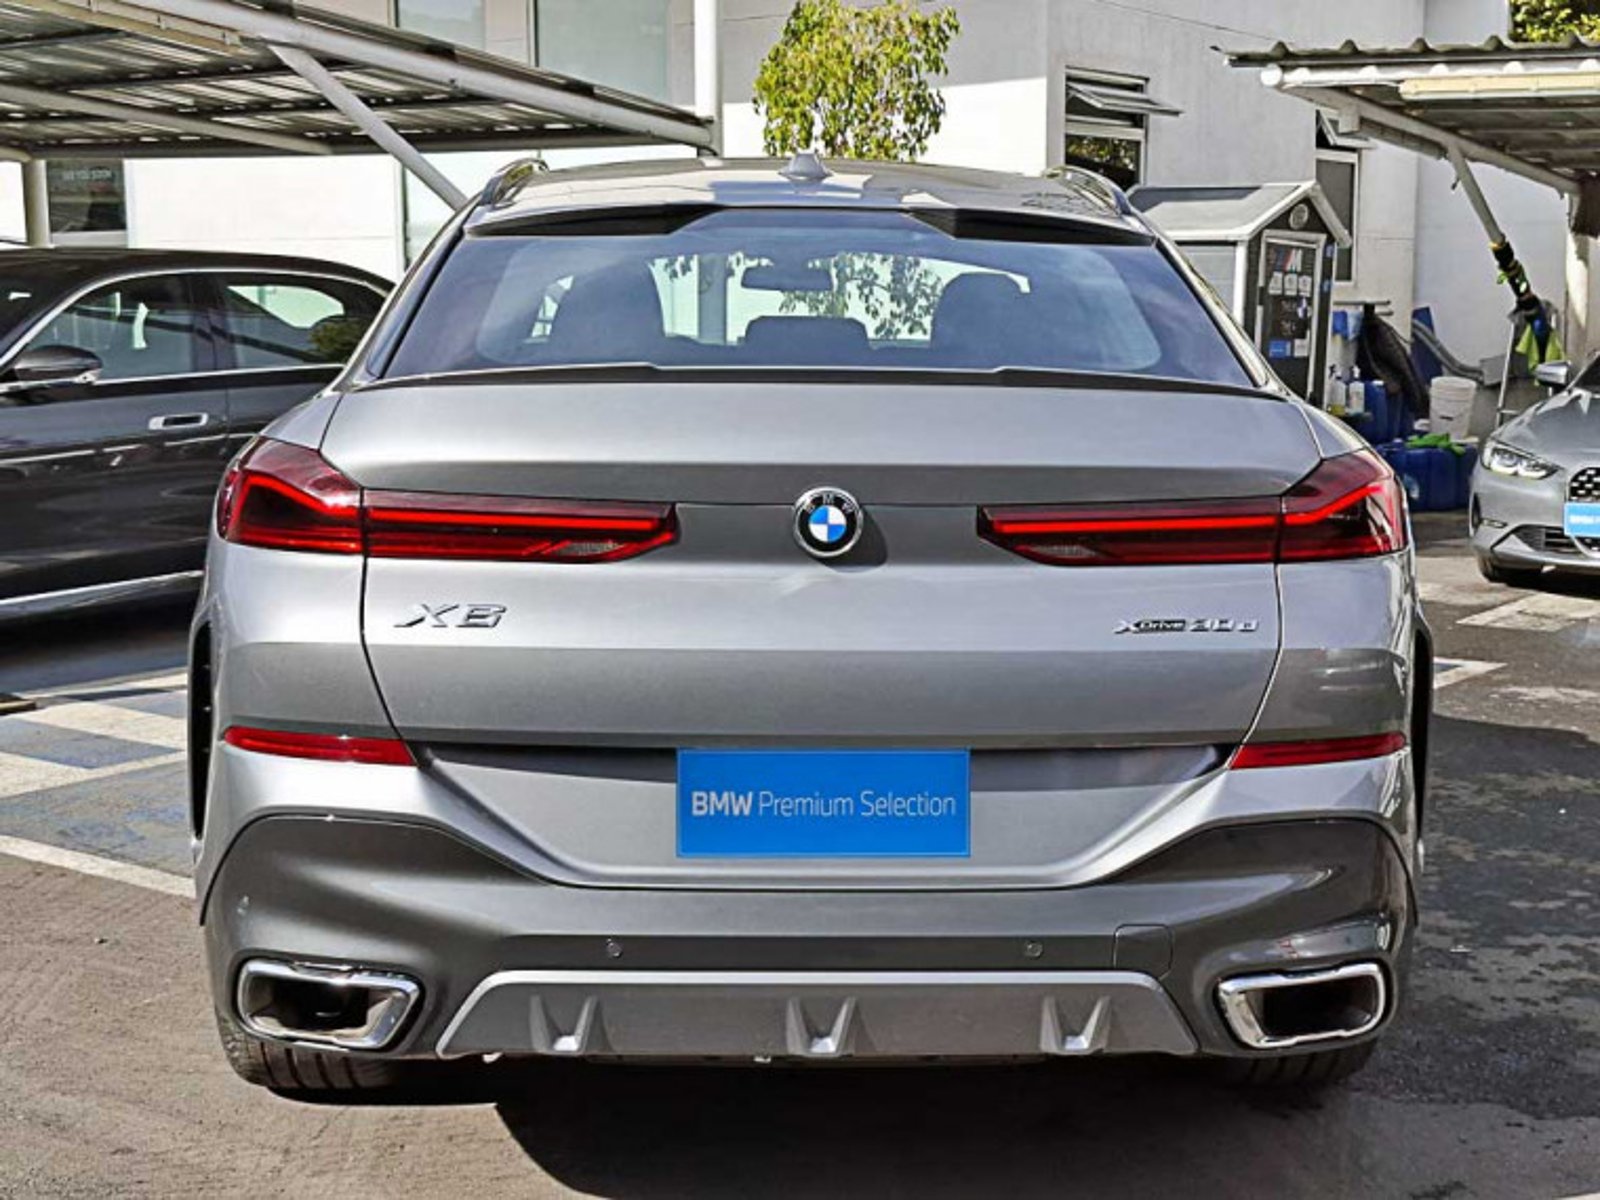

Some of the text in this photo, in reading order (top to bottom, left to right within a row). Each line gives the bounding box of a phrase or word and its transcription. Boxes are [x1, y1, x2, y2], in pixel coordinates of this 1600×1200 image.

[691, 790, 956, 817] BMW Premium Selection
